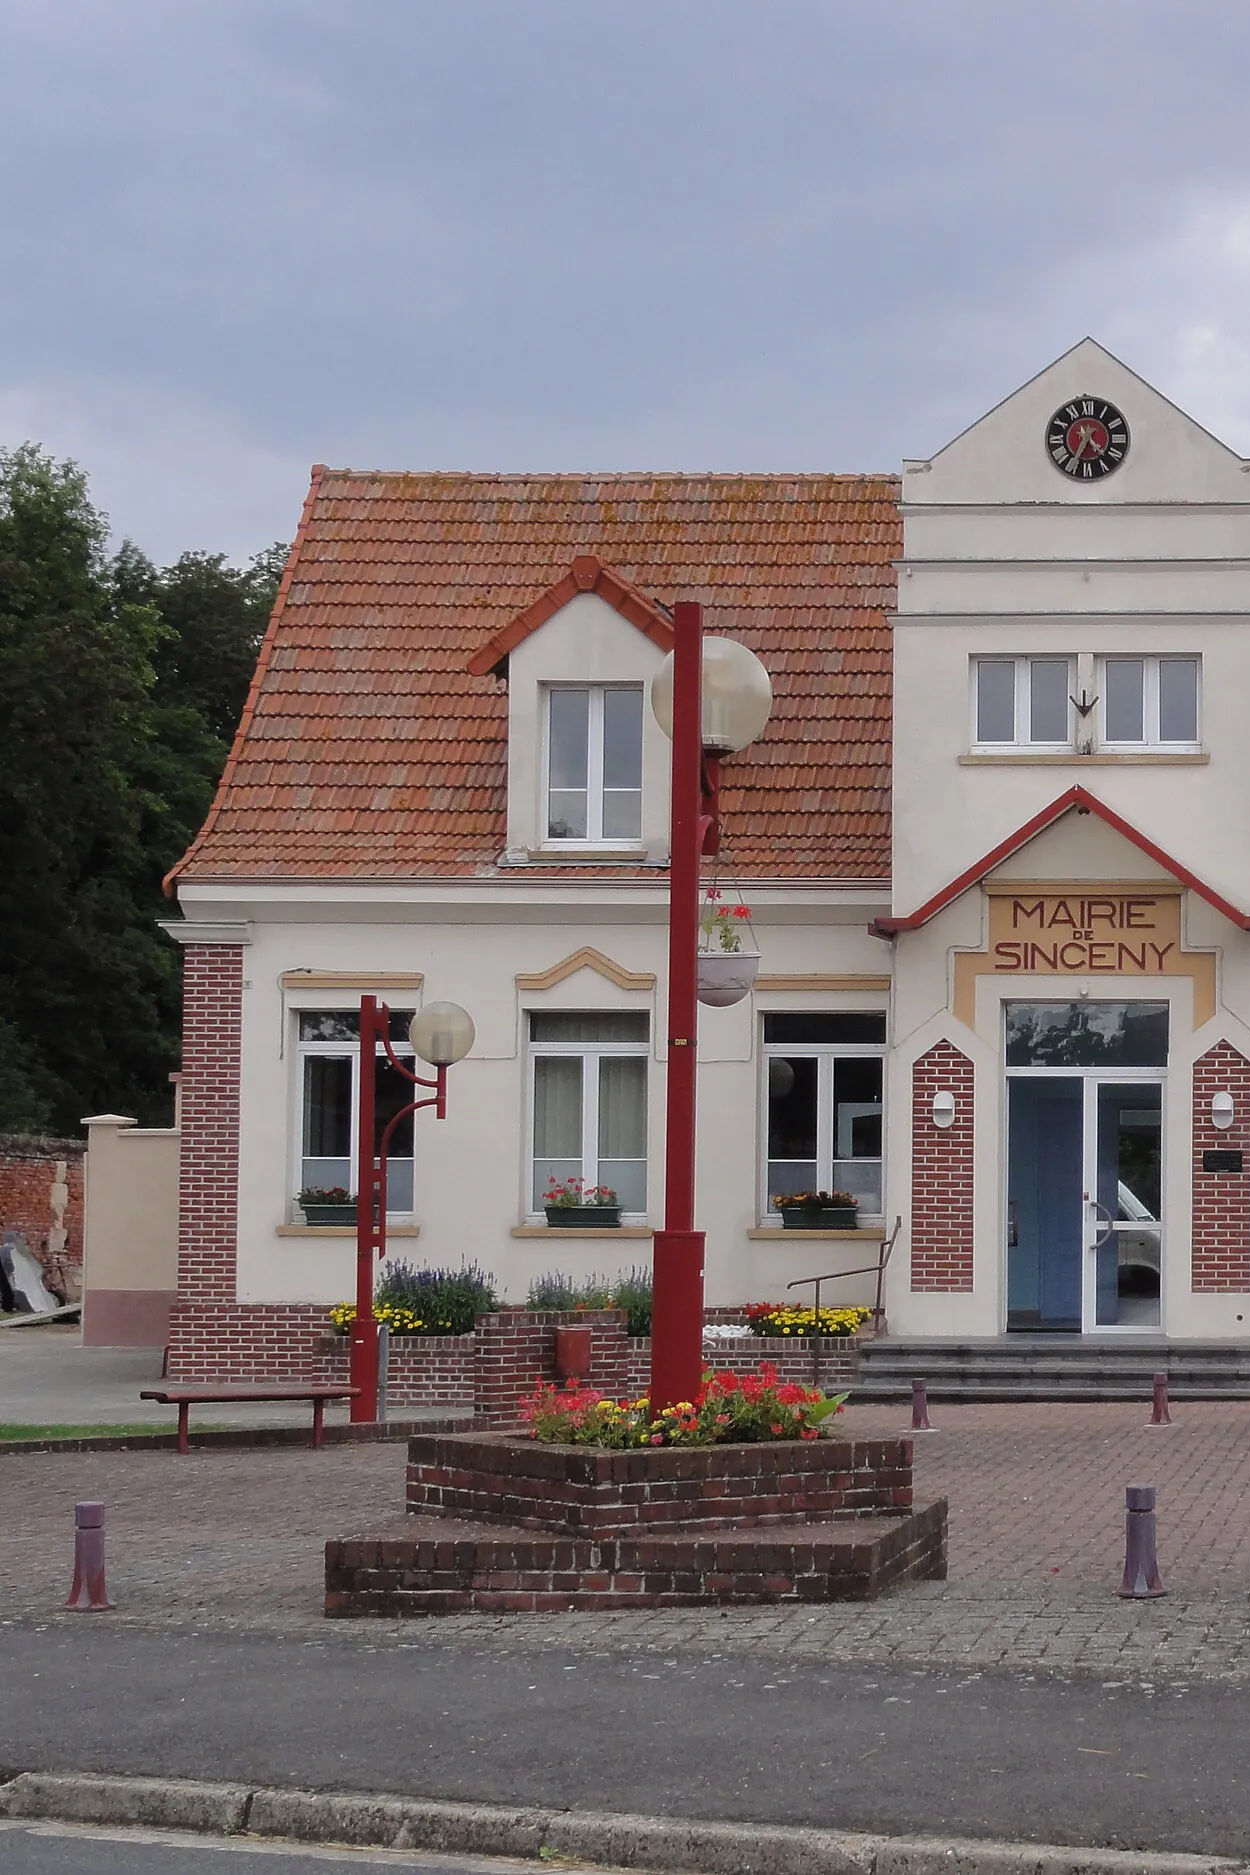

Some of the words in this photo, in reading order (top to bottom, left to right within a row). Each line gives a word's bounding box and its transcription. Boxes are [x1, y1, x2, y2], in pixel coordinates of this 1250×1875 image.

[1082, 401, 1094, 415] XII
[1012, 901, 1156, 928] MAIRIE
[1072, 930, 1094, 940] DE
[994, 942, 1175, 970] SINCENY
